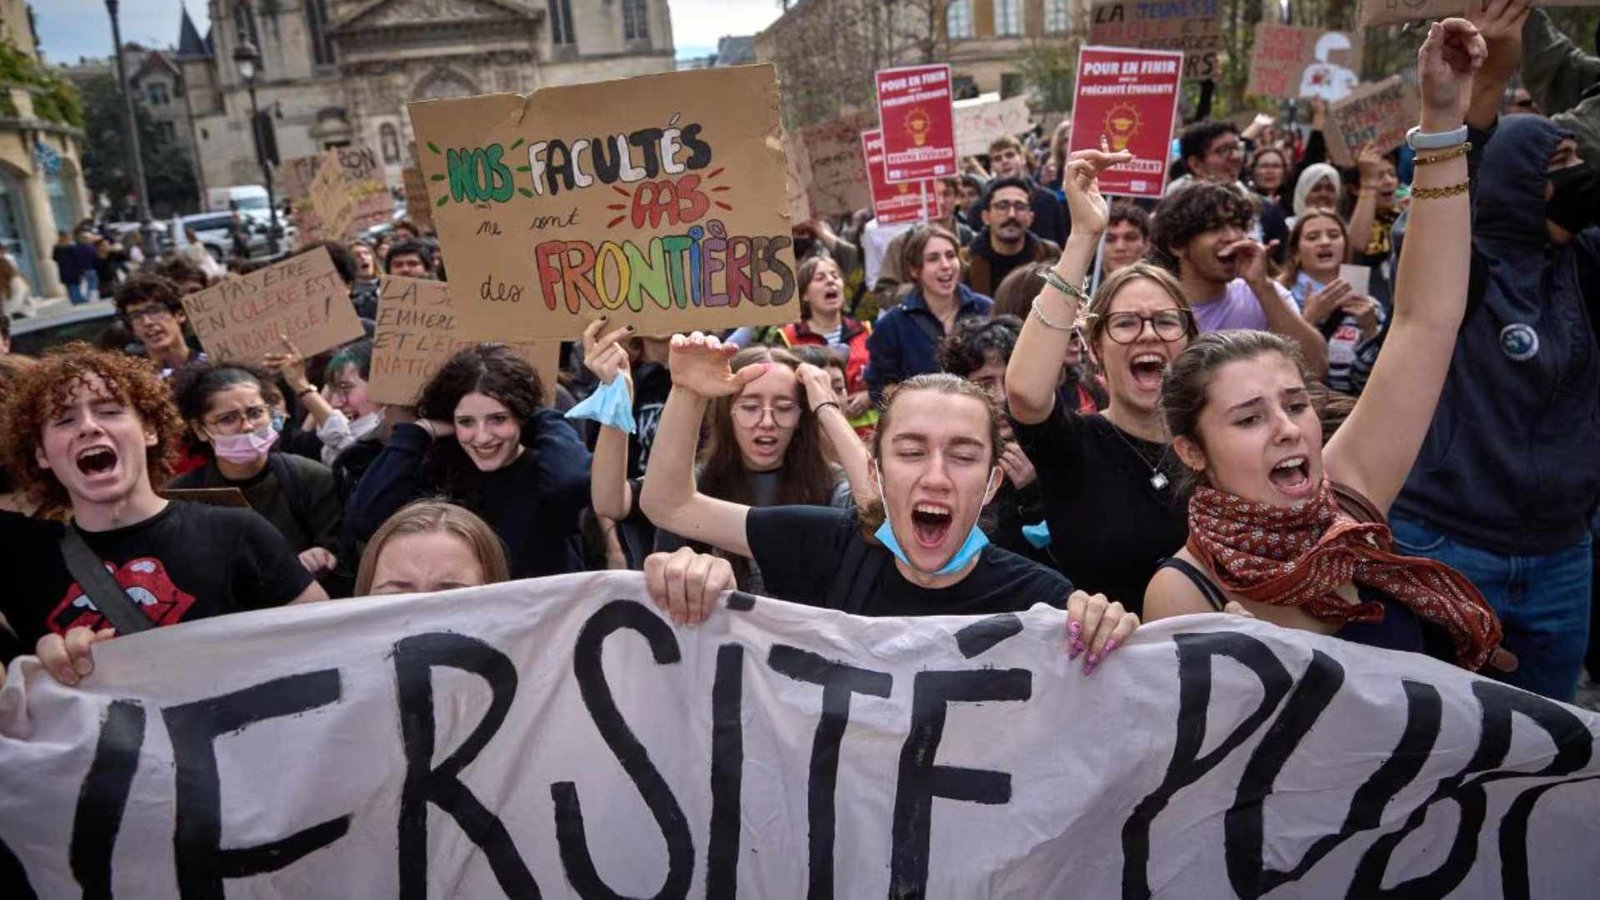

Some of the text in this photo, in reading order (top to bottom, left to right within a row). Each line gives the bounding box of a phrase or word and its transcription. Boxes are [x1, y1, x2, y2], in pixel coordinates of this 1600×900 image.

[881, 77, 907, 92] POUR
[908, 75, 921, 87] EN
[922, 70, 946, 84] FINIR
[1084, 60, 1176, 75] POUR EN FINIR
[446, 143, 515, 204] NOS
[527, 112, 711, 196] FACULTÉS
[476, 174, 710, 236] ne sont PAS
[480, 219, 796, 315] des FRONTIÈRES
[185, 297, 213, 315] NE
[219, 278, 257, 303] PAS
[195, 313, 226, 338] EN
[305, 272, 336, 296] EST
[381, 280, 417, 306] LA
[373, 331, 414, 349] ET
